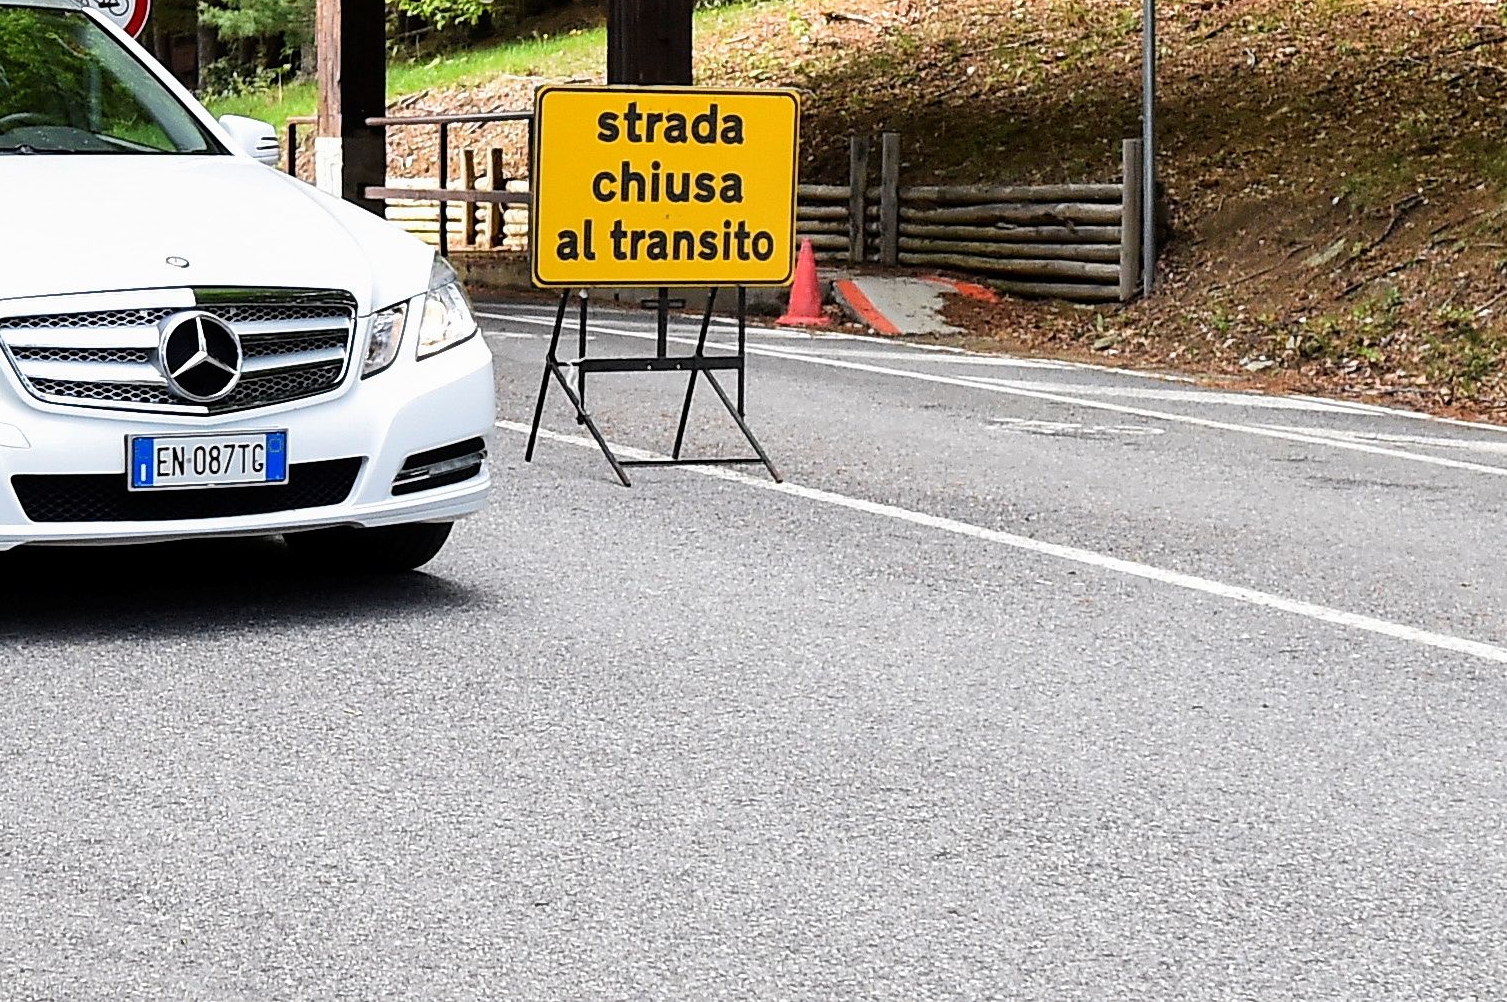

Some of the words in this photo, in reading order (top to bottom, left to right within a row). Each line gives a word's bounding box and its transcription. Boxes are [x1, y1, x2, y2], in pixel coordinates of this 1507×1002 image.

[597, 101, 744, 145] strada
[592, 160, 743, 204] chiusa
[555, 219, 596, 262] al
[610, 219, 775, 262] transito
[156, 446, 185, 477] EN
[193, 443, 264, 476] 087TG
